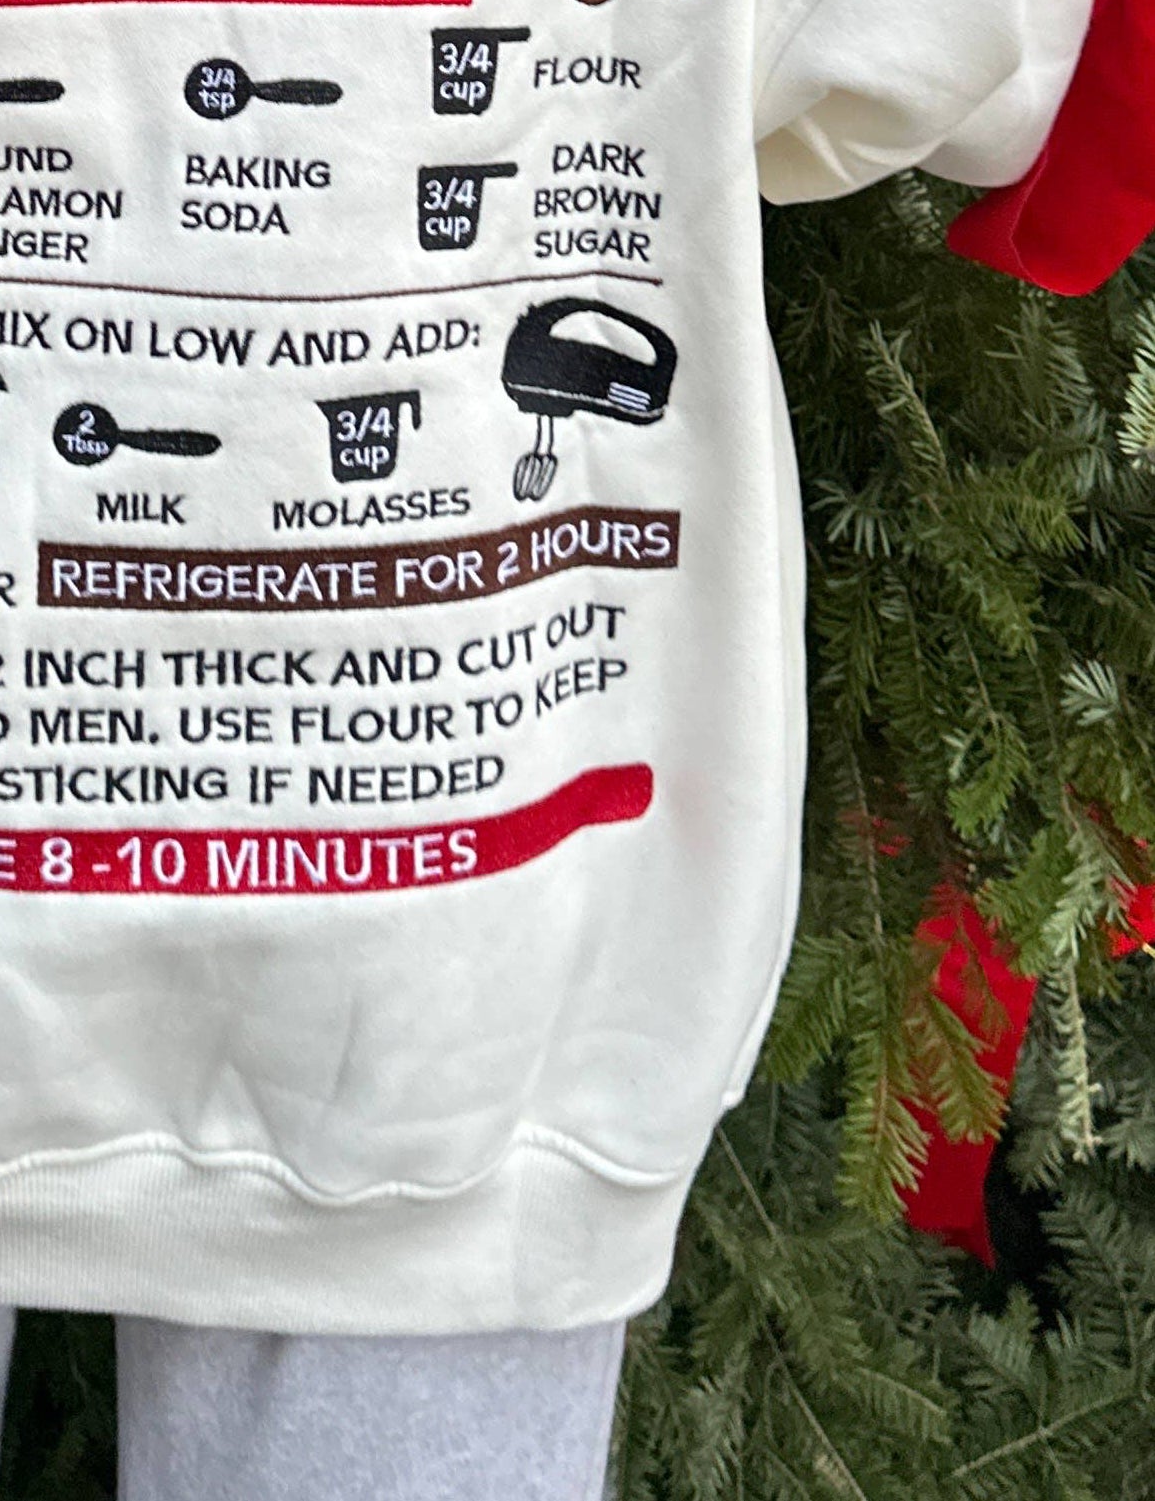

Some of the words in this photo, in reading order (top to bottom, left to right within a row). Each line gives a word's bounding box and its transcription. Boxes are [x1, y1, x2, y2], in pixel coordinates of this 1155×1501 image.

[439, 42, 493, 75] 3/4
[535, 58, 640, 89] FLOUR
[201, 67, 236, 91] 3/4
[440, 81, 486, 103] cup
[199, 89, 235, 114] tsp
[186, 155, 330, 189] BAKING
[553, 143, 644, 177] DARK
[424, 177, 477, 211] 3/4
[535, 185, 661, 219] BROWN
[182, 200, 289, 234] SODA
[426, 216, 471, 242] cup
[536, 229, 650, 262] SUGAR
[65, 318, 133, 353] ON
[150, 322, 255, 366] LOW
[268, 331, 369, 366] AND
[385, 320, 479, 359] ADD:
[77, 409, 96, 435] 2
[337, 406, 394, 442] 3/4
[62, 434, 110, 457] Tbsp
[340, 446, 390, 473] cup
[97, 494, 185, 524] MILK
[274, 489, 470, 529] MOLASSES
[53, 559, 377, 602] REFRIGERATE
[396, 551, 484, 597] FOR
[497, 542, 520, 581] 2
[528, 520, 672, 575] HOURS
[25, 650, 144, 688] INCH
[162, 650, 315, 685] THICK
[331, 648, 440, 685] AND
[458, 627, 534, 674] CUT
[547, 604, 625, 648] OUT
[31, 708, 158, 744] MEN.
[181, 708, 272, 742] USE
[292, 705, 453, 743] FLOUR
[467, 694, 522, 734] TO
[537, 659, 626, 715] KEEP
[250, 767, 290, 804] IF
[310, 757, 503, 804] NEEDED
[40, 838, 73, 883] 8
[208, 829, 478, 890] MINUTES
